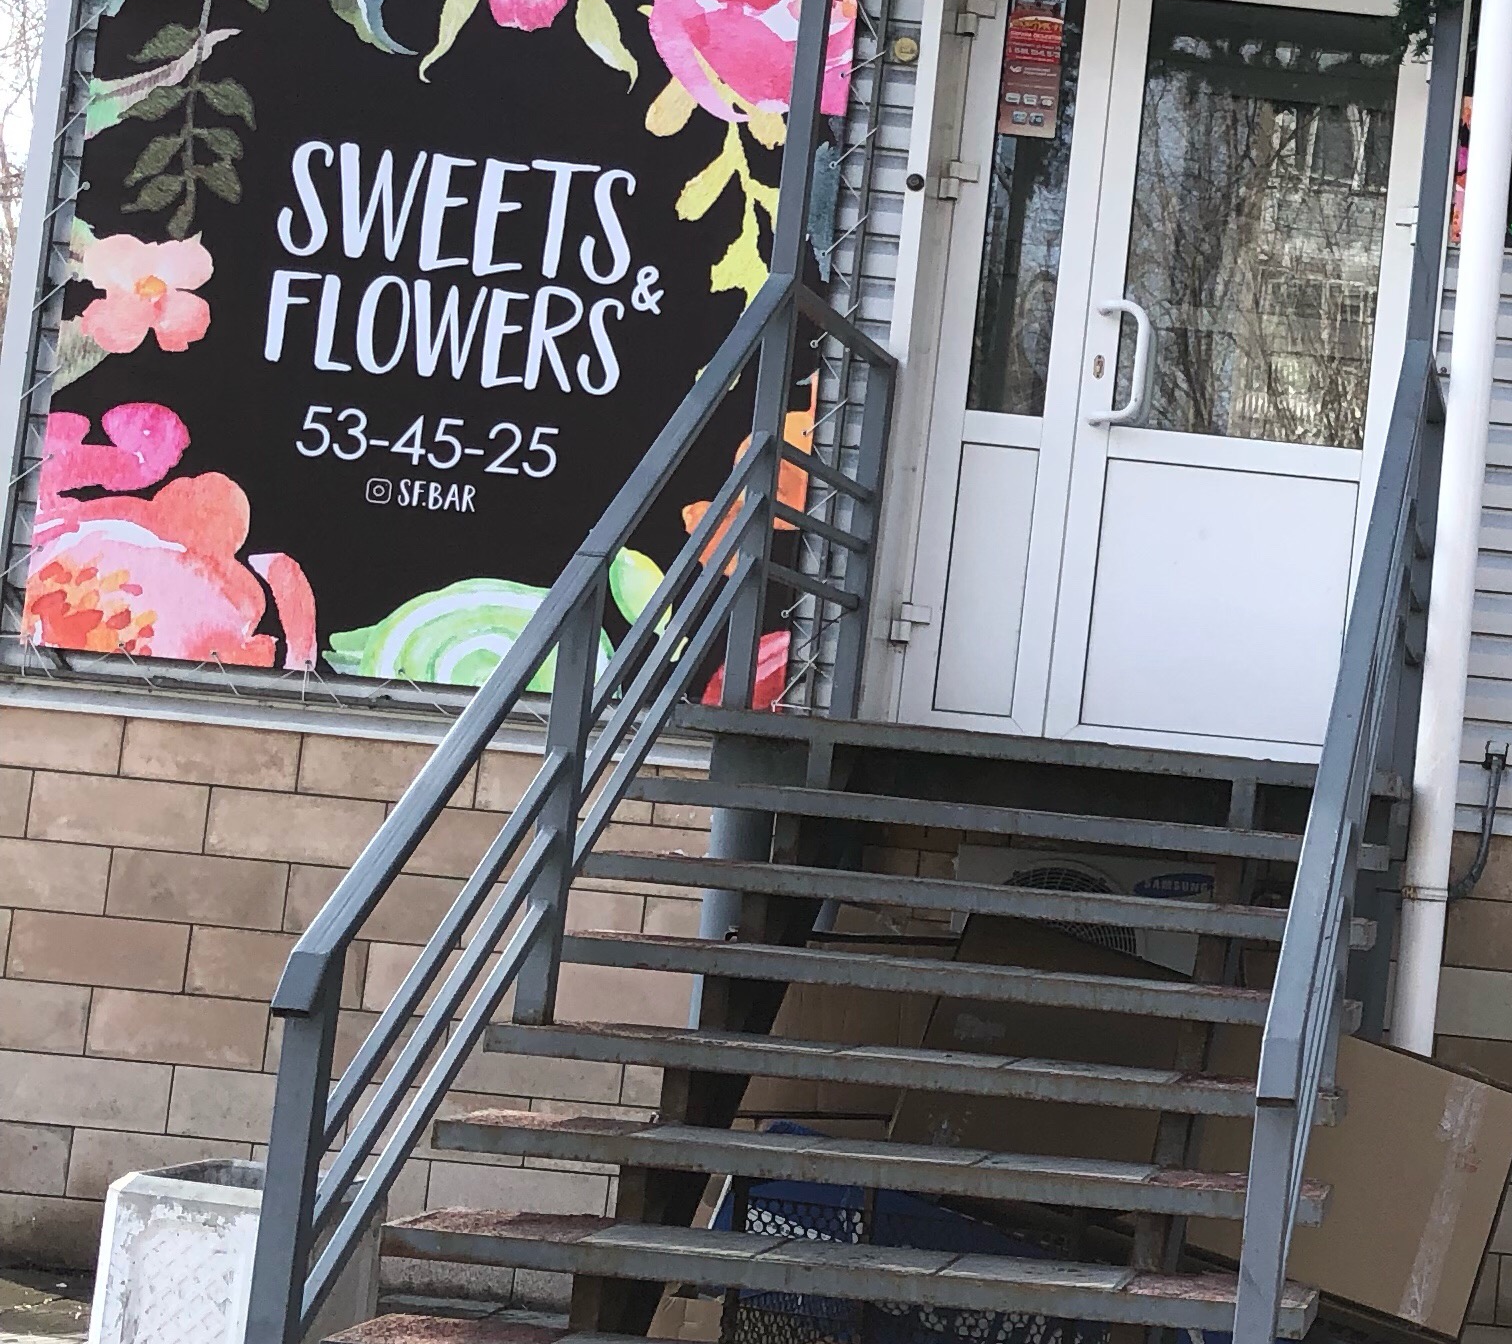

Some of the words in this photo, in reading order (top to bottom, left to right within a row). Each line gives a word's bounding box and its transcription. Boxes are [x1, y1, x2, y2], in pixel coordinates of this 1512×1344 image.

[276, 140, 636, 285] SWEETS
[631, 266, 664, 315] &
[264, 269, 624, 396] FLOWERS
[296, 405, 559, 478] 53-45-25
[397, 479, 476, 513] SF.BAR
